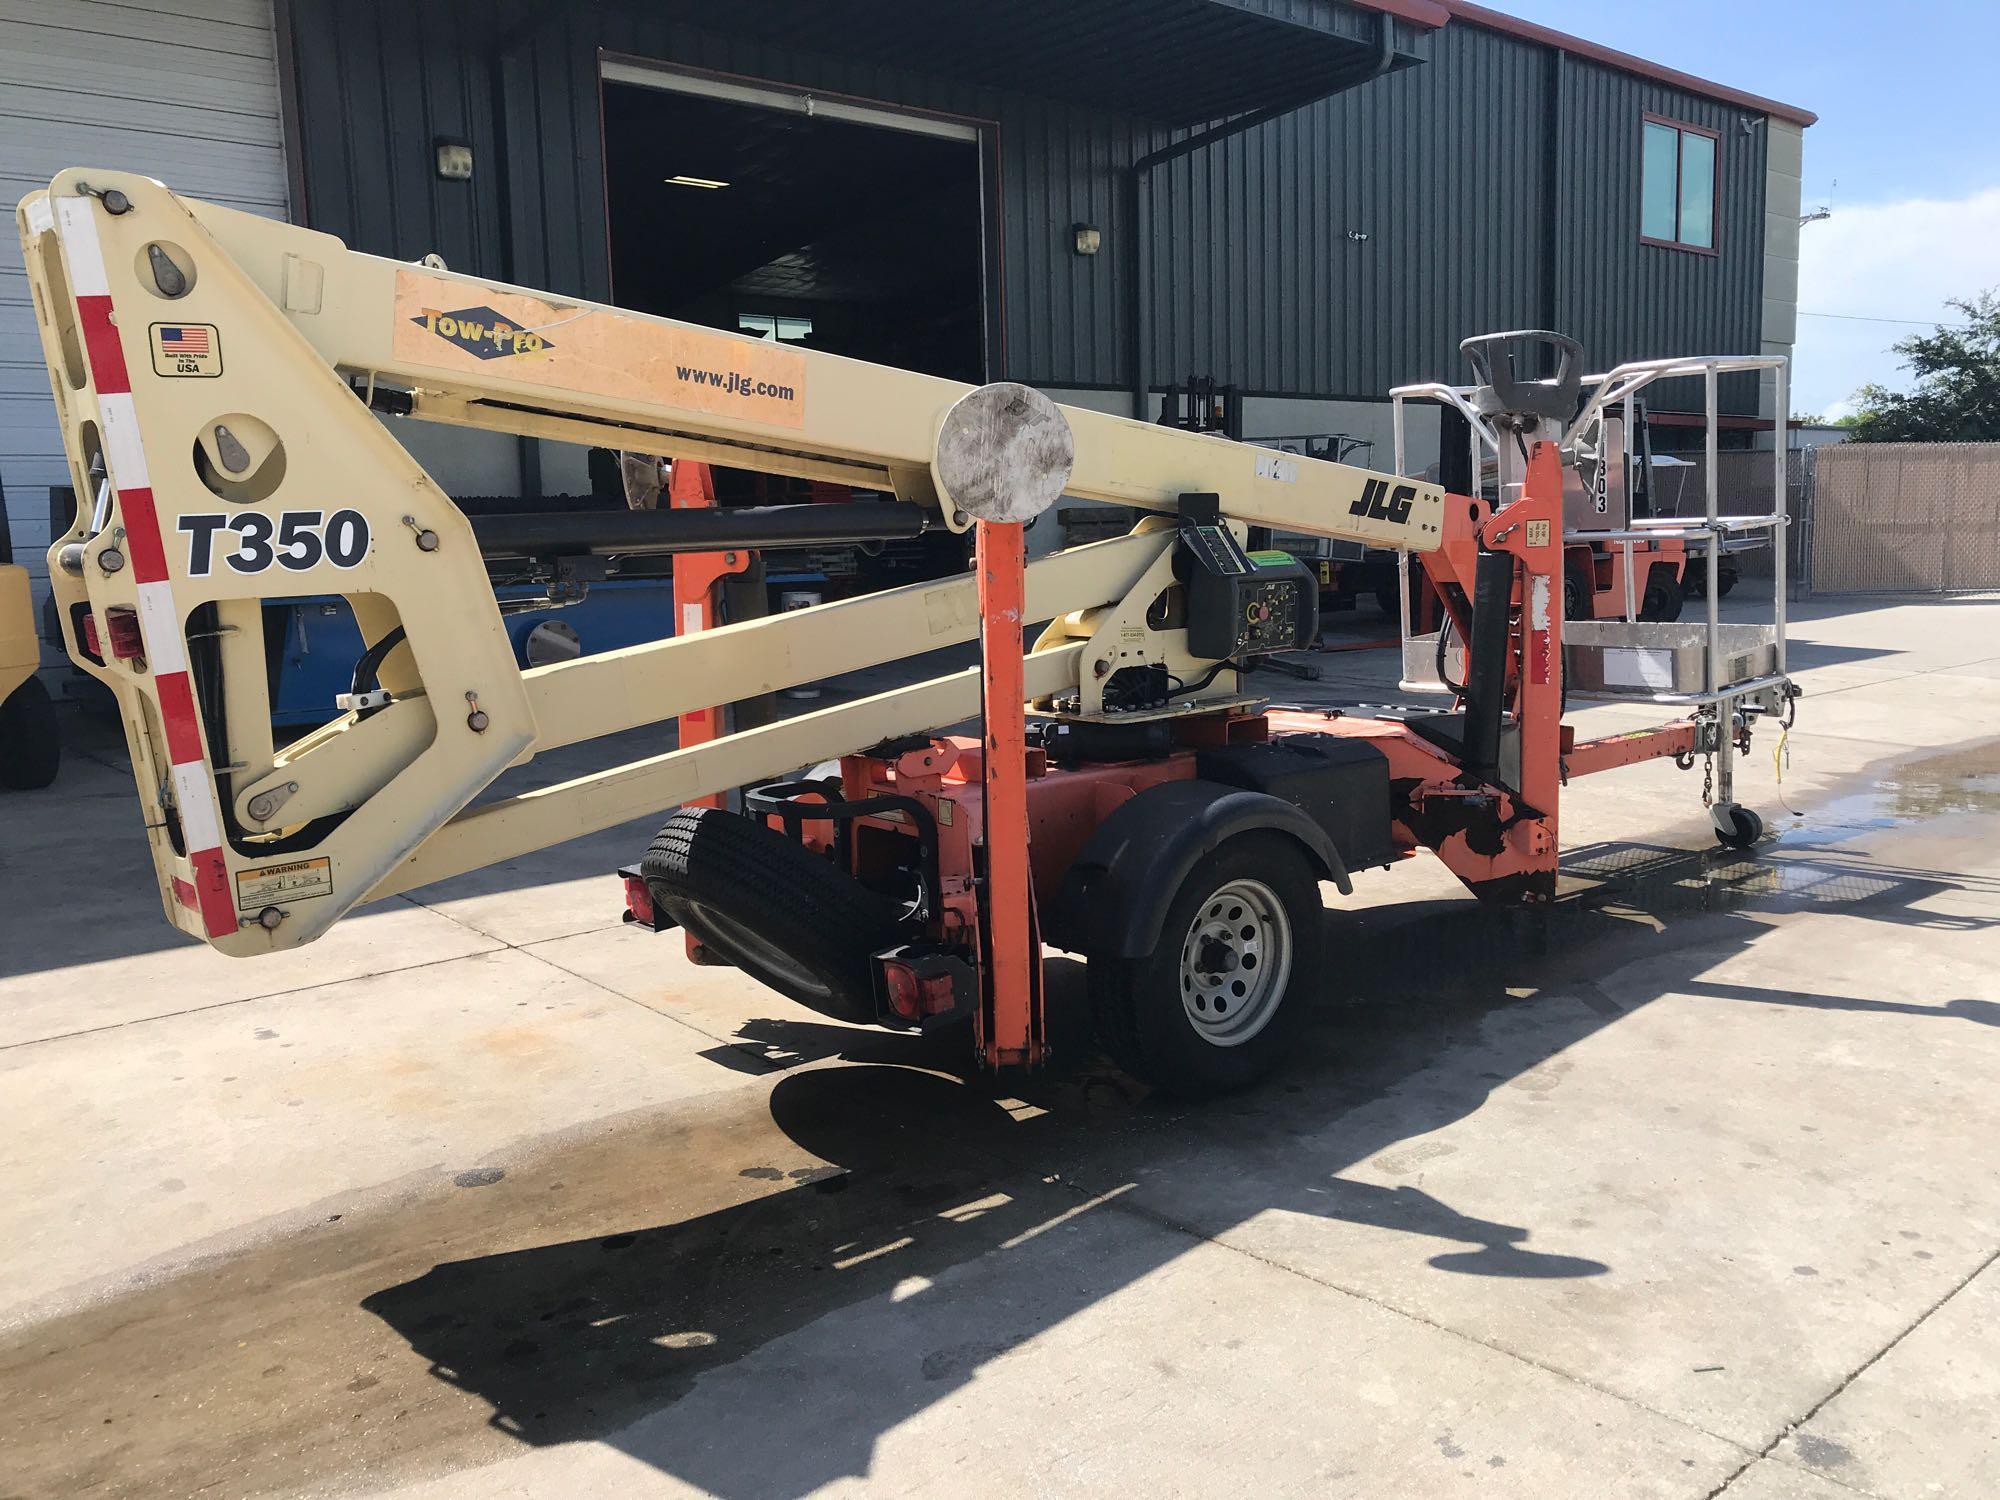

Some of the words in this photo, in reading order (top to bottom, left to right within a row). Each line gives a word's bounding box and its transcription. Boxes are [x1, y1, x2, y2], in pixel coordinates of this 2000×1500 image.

[177, 364, 200, 373] USA
[676, 366, 794, 401] www.jlg.com
[1348, 478, 1417, 525] JLG
[177, 508, 370, 577] T350
[266, 862, 310, 875] WARNING
